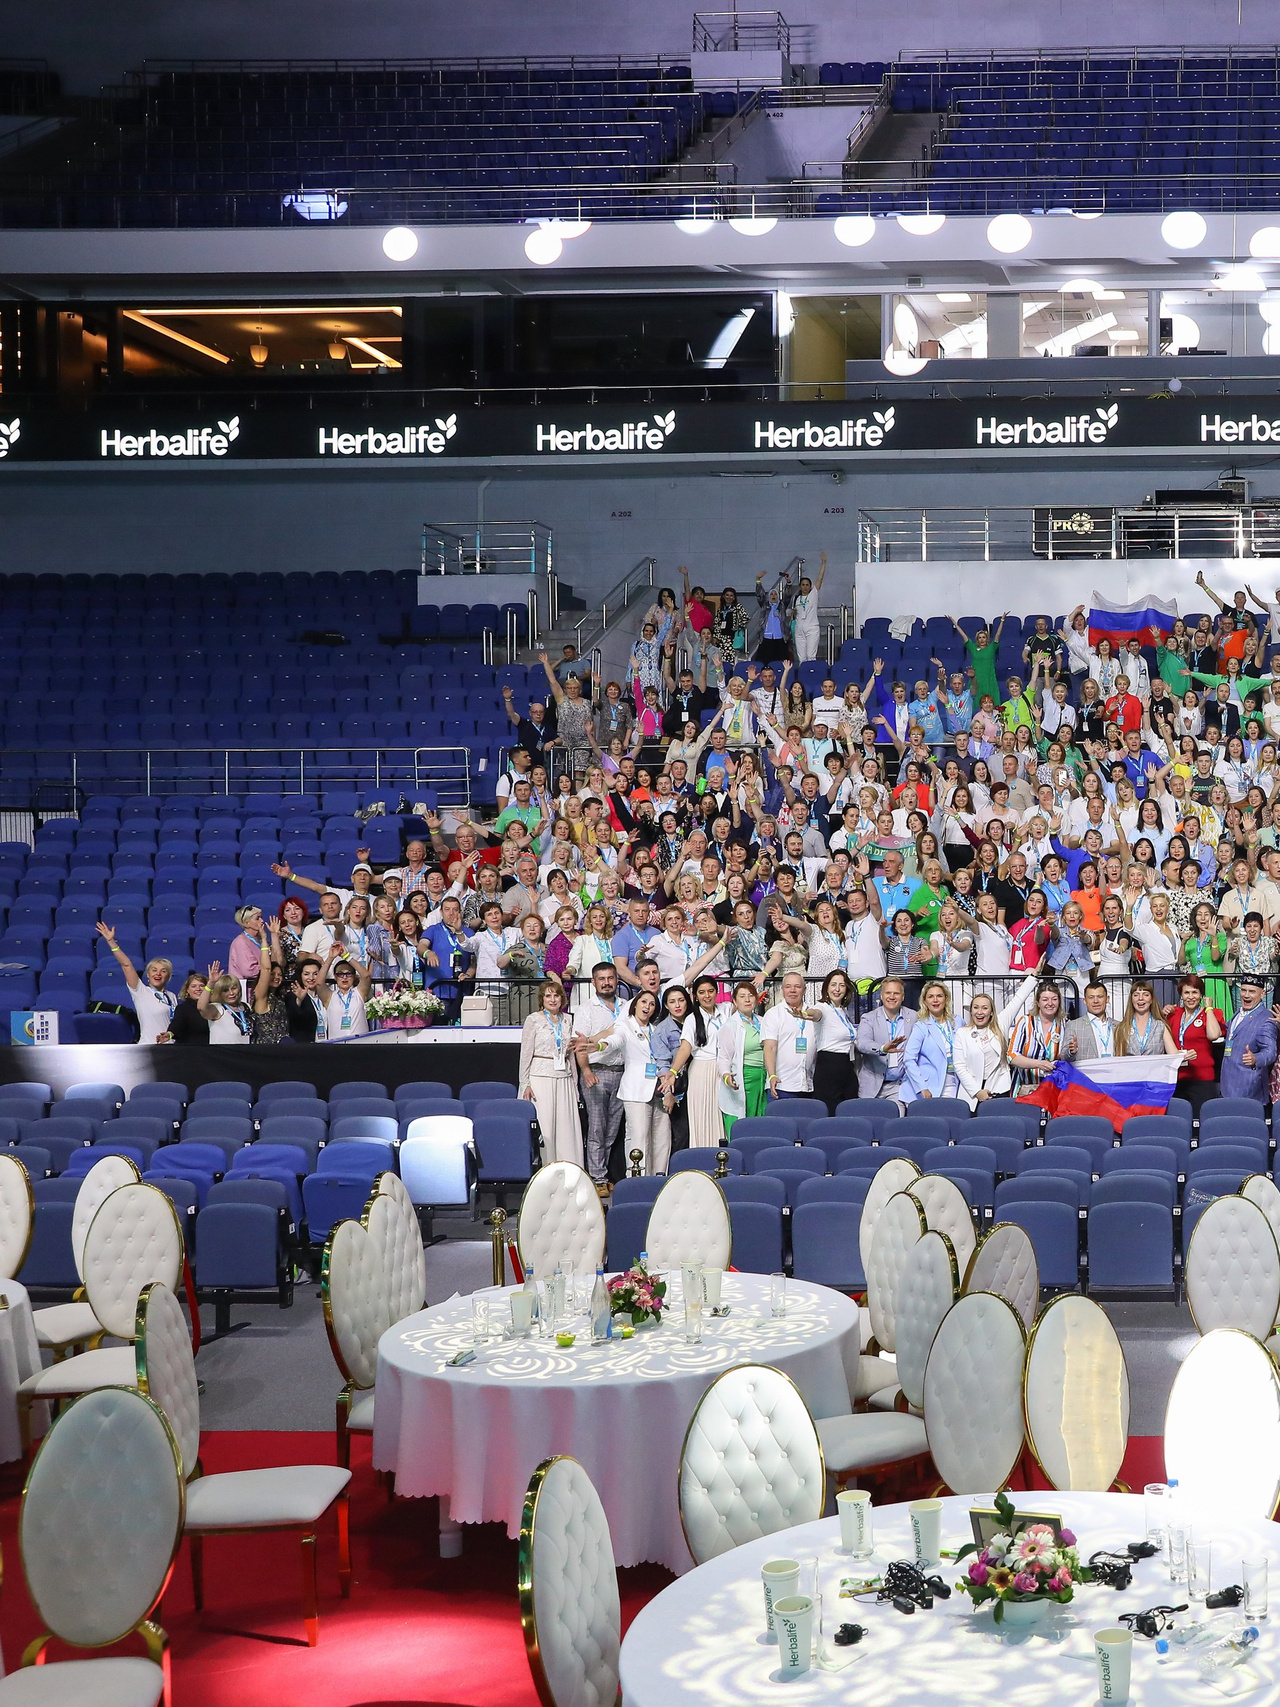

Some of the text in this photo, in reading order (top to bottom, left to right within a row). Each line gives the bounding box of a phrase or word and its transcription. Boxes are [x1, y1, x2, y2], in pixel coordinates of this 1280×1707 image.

[101, 428, 228, 457] Herbalife
[319, 426, 446, 455] Herbalife
[537, 422, 664, 451] Herbalife
[755, 419, 884, 449] Herbalife
[977, 415, 1107, 445] Herbalife
[912, 1518, 922, 1559] Herbalife
[764, 1587, 775, 1631] Herbalife
[787, 1622, 800, 1667] Herbalife
[1100, 1652, 1112, 1699] Herbalife
